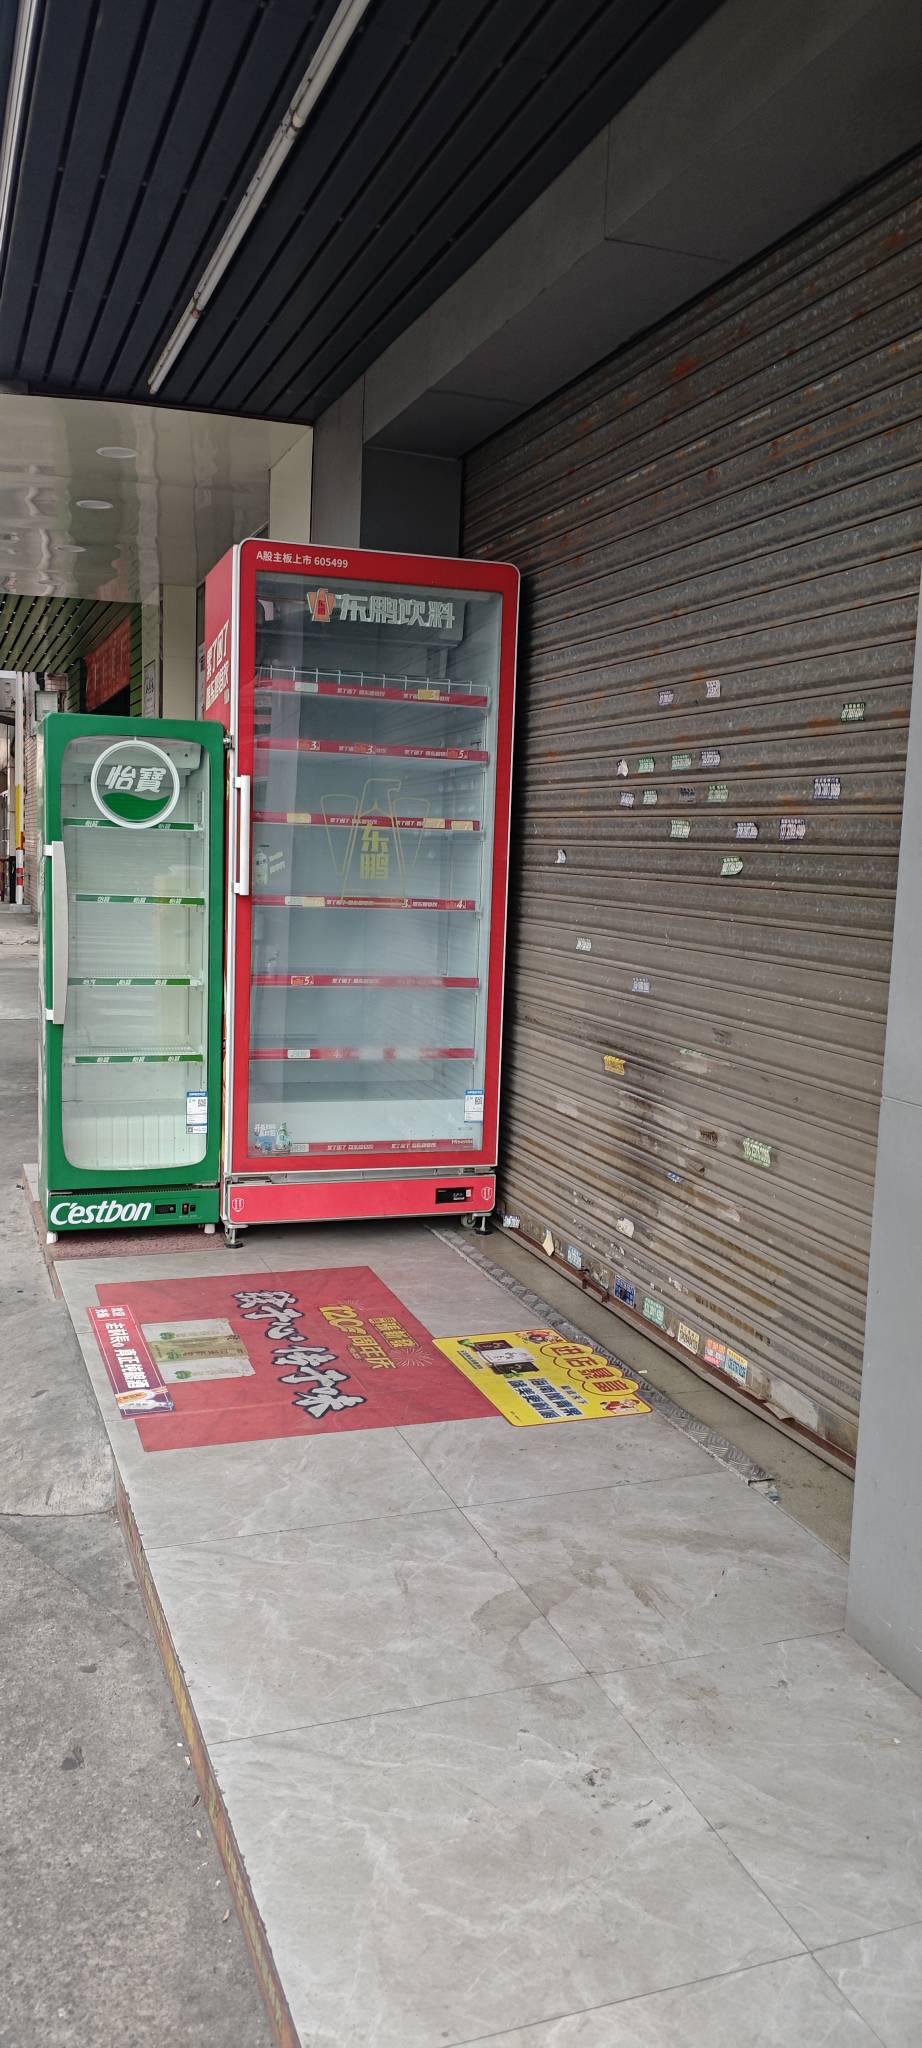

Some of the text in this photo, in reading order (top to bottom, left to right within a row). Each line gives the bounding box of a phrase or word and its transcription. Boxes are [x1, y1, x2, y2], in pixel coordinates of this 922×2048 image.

[256, 551, 349, 569] A股主板上市 605499
[335, 593, 456, 629] 东鹏饮料
[50, 1200, 152, 1226] C'estbon
